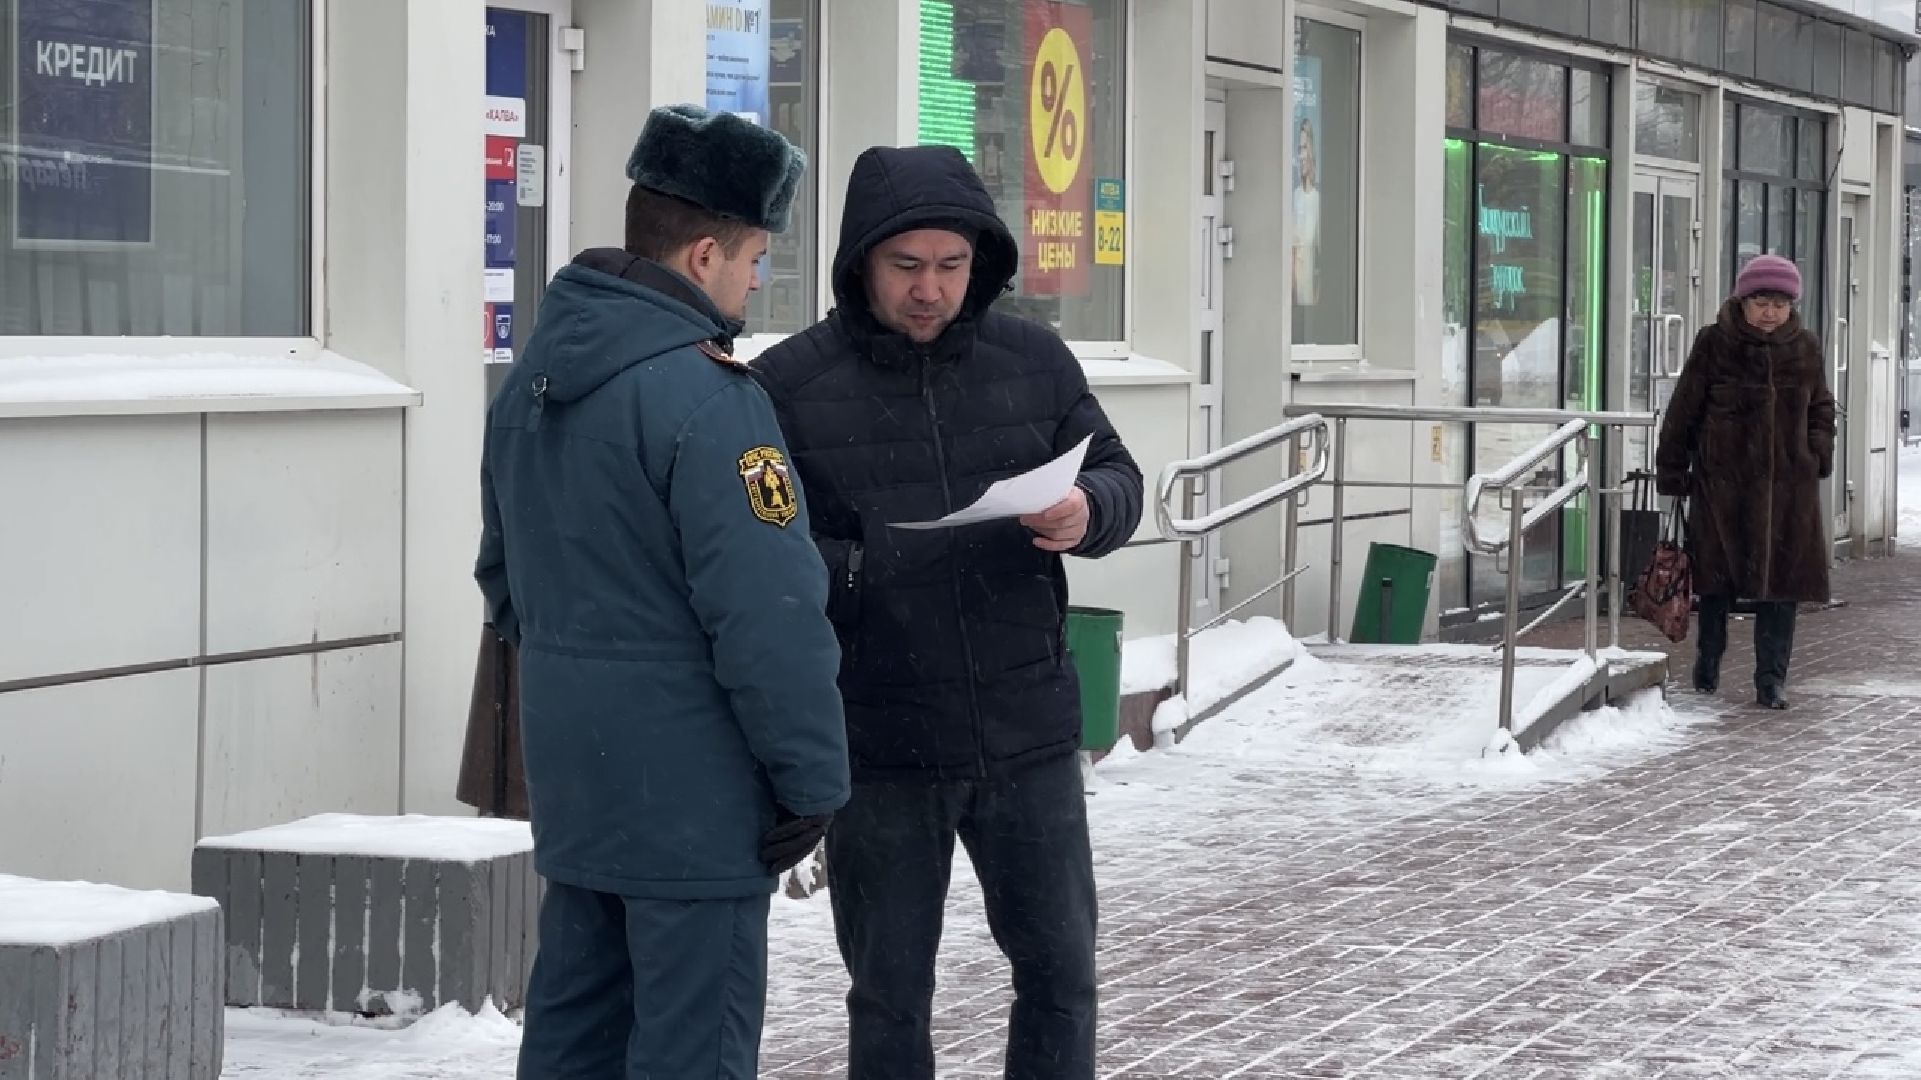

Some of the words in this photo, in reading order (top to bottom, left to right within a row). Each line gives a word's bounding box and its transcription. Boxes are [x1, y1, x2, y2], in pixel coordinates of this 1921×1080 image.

[706, 4, 733, 31] АМИН
[36, 40, 138, 87] КРЕДИТ
[1041, 60, 1077, 161] %
[1031, 209, 1083, 237] НИЗКИЕ
[1098, 225, 1120, 252] 8-22
[1038, 244, 1075, 274] ЦЕНЫ
